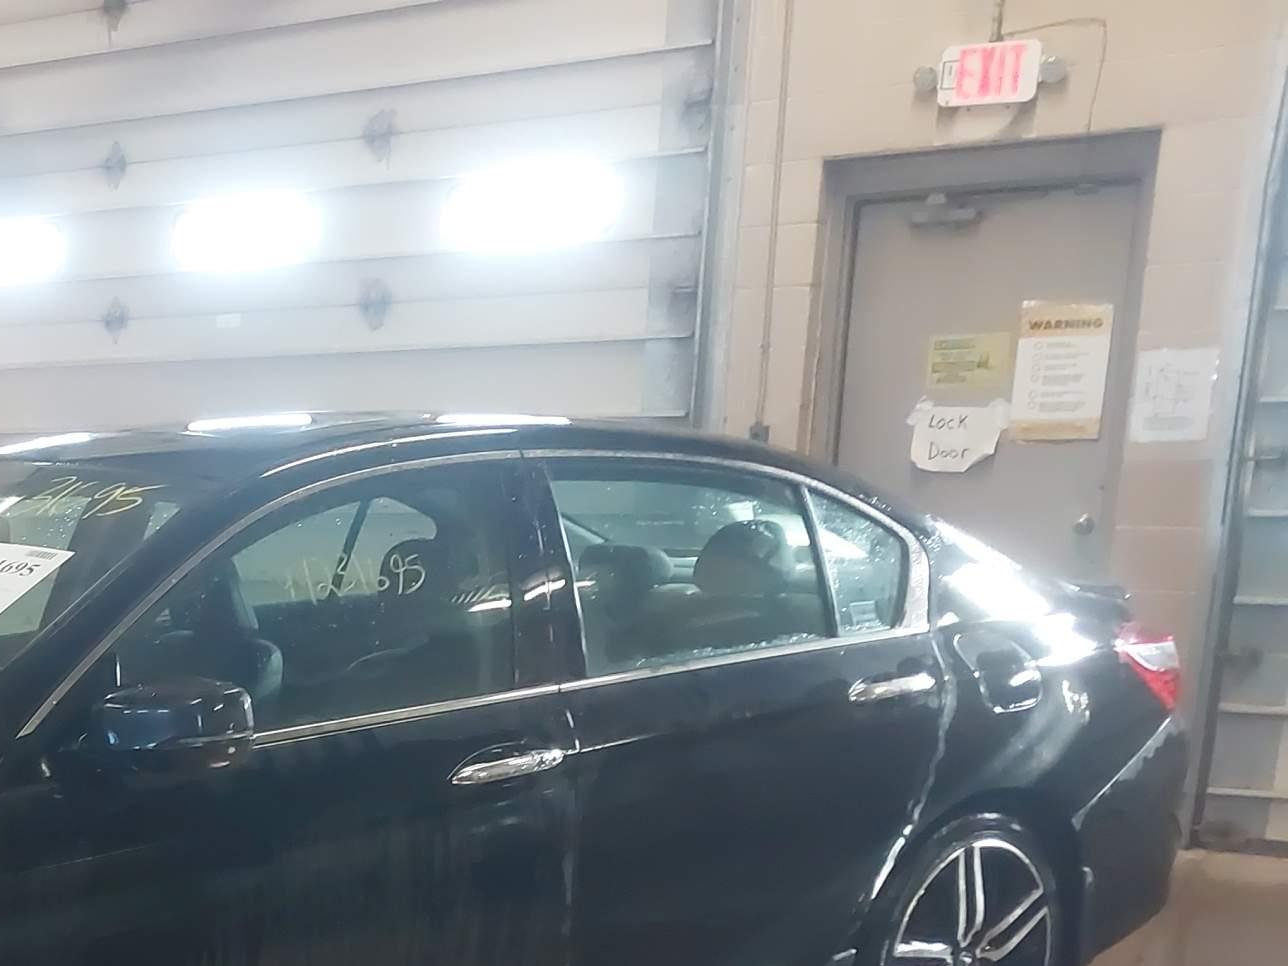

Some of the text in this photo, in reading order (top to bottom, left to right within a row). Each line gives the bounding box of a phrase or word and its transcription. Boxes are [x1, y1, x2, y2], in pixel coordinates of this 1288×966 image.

[956, 45, 1027, 99] EXIT
[1028, 318, 1104, 331] WARNING
[927, 441, 970, 461] Door
